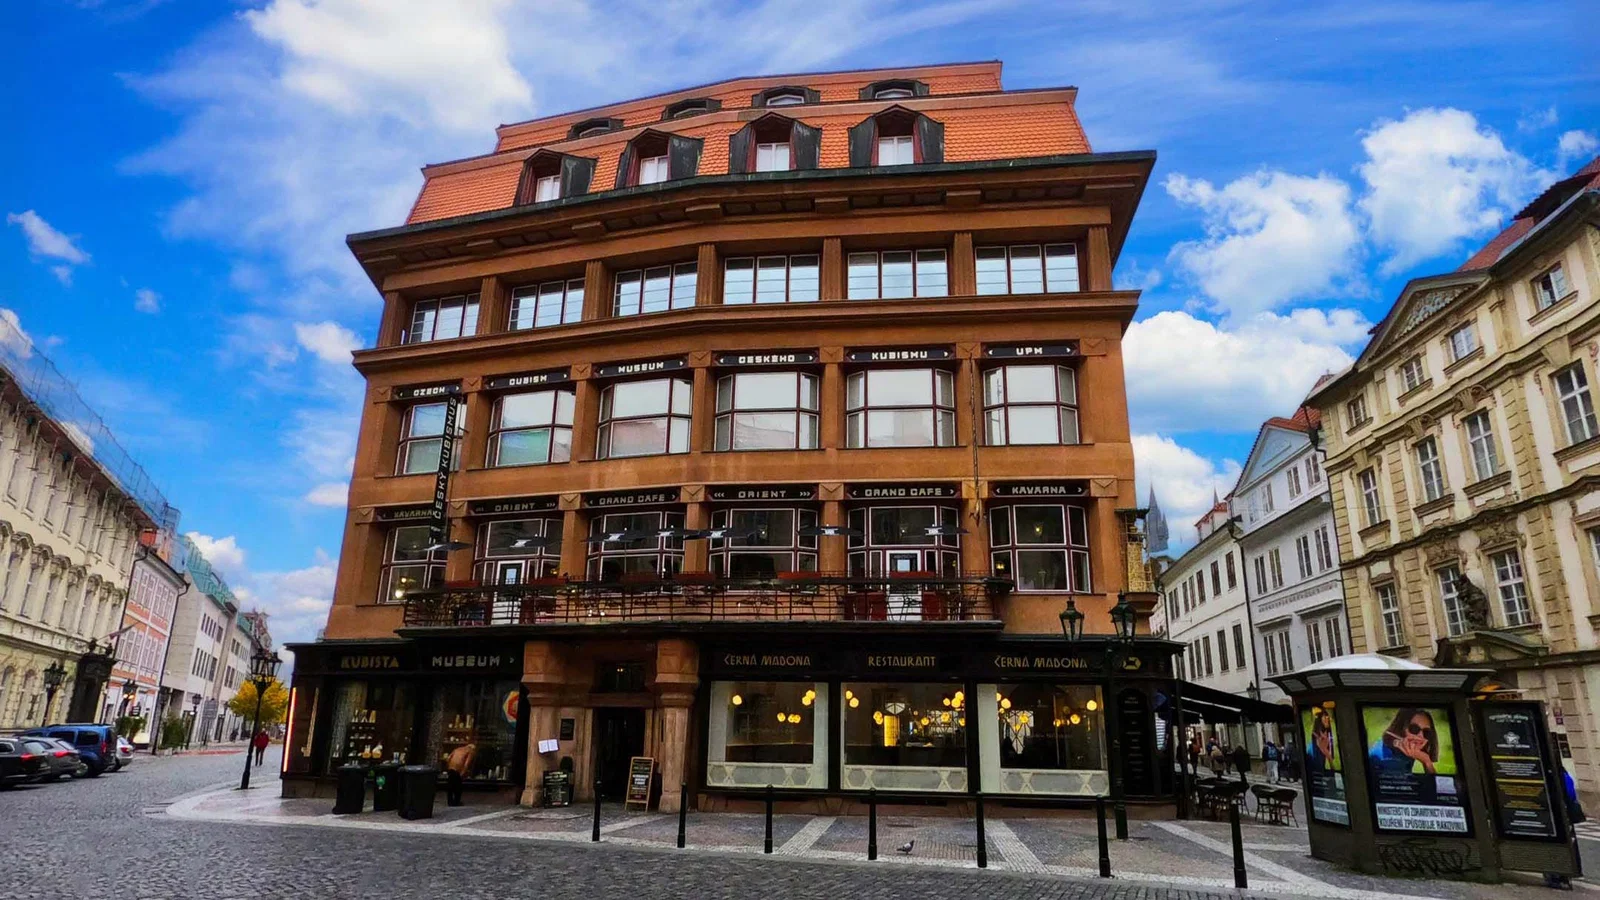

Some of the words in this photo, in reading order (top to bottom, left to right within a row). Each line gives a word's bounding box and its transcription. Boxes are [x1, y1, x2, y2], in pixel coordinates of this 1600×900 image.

[871, 350, 928, 360] KUBISMU
[1016, 347, 1043, 355] UPM
[617, 361, 665, 373] MUSEUM
[509, 374, 548, 386] CUBISM
[413, 386, 446, 397] CZECH
[441, 397, 457, 468] KUBISMUS
[738, 490, 787, 499] ORIENT
[864, 488, 906, 497] GRAND
[599, 495, 634, 505] GRAND
[494, 502, 536, 512] ORIENT
[340, 655, 400, 669] KUBISTA
[432, 655, 500, 667] MUSEUM
[761, 655, 811, 666] MADONA
[868, 655, 936, 667] RESTAURANT
[1034, 657, 1088, 669] MADONA
